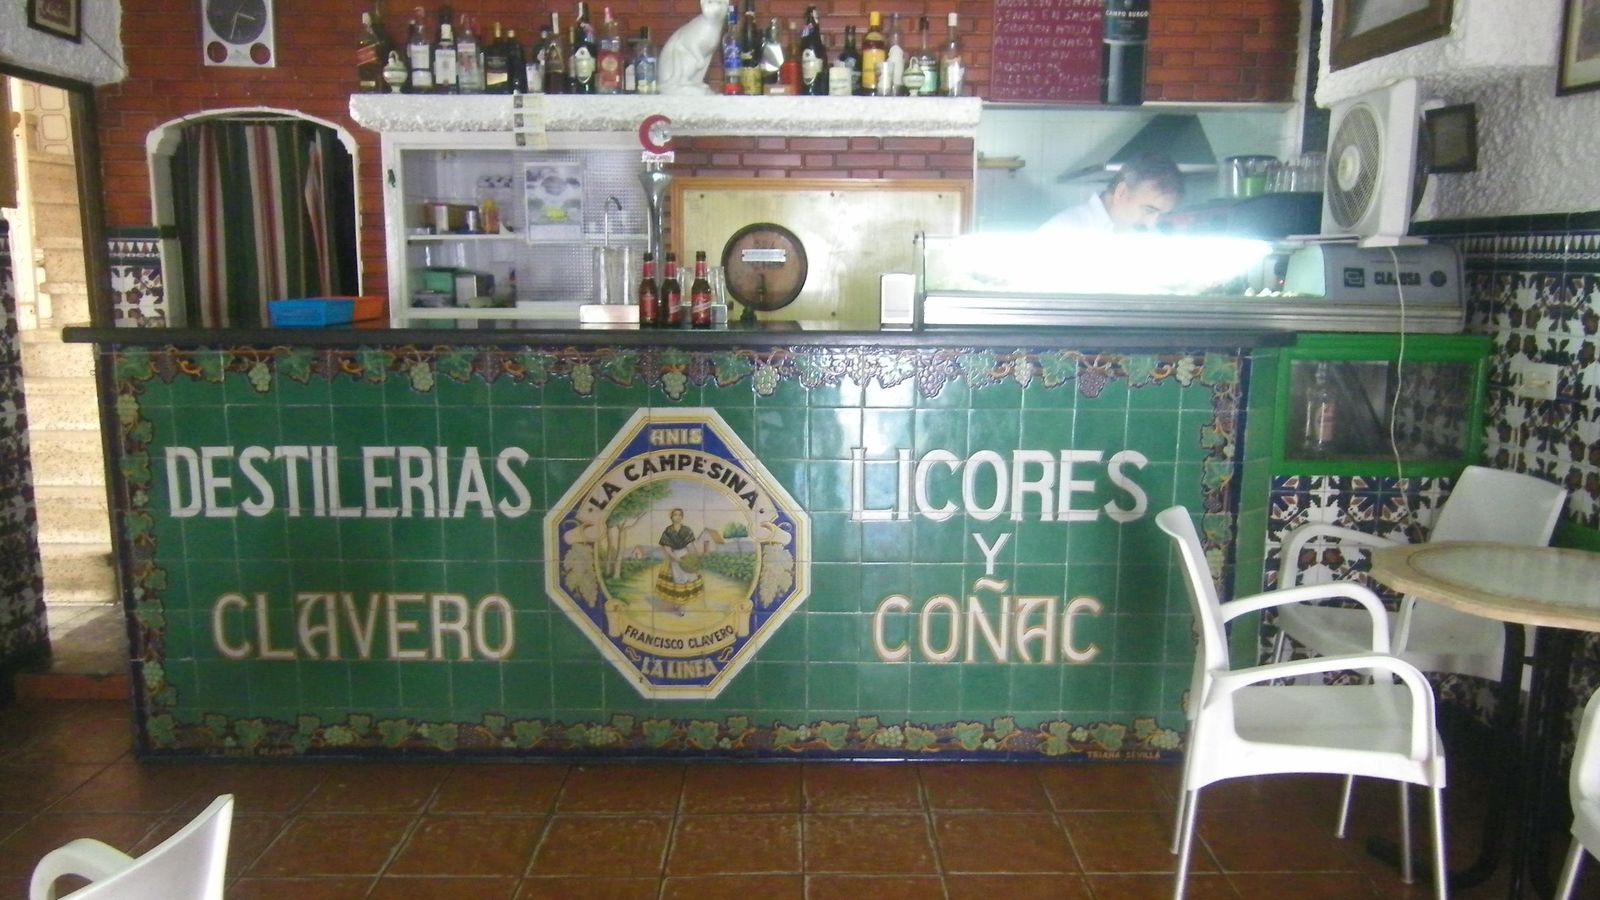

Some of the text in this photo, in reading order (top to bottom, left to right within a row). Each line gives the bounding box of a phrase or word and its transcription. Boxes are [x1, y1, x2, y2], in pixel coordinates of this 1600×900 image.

[649, 428, 703, 446] ANIS
[164, 445, 532, 519] DESTILERIAS
[589, 453, 759, 511] LA CAMPESINA
[849, 447, 1149, 523] LICORES
[972, 533, 1012, 575] Y
[211, 591, 516, 661] CLAVERO
[624, 625, 735, 650] FRANCISCO CLAVERO
[873, 576, 1103, 665] COÑAC
[640, 656, 720, 679] LA LINEA
